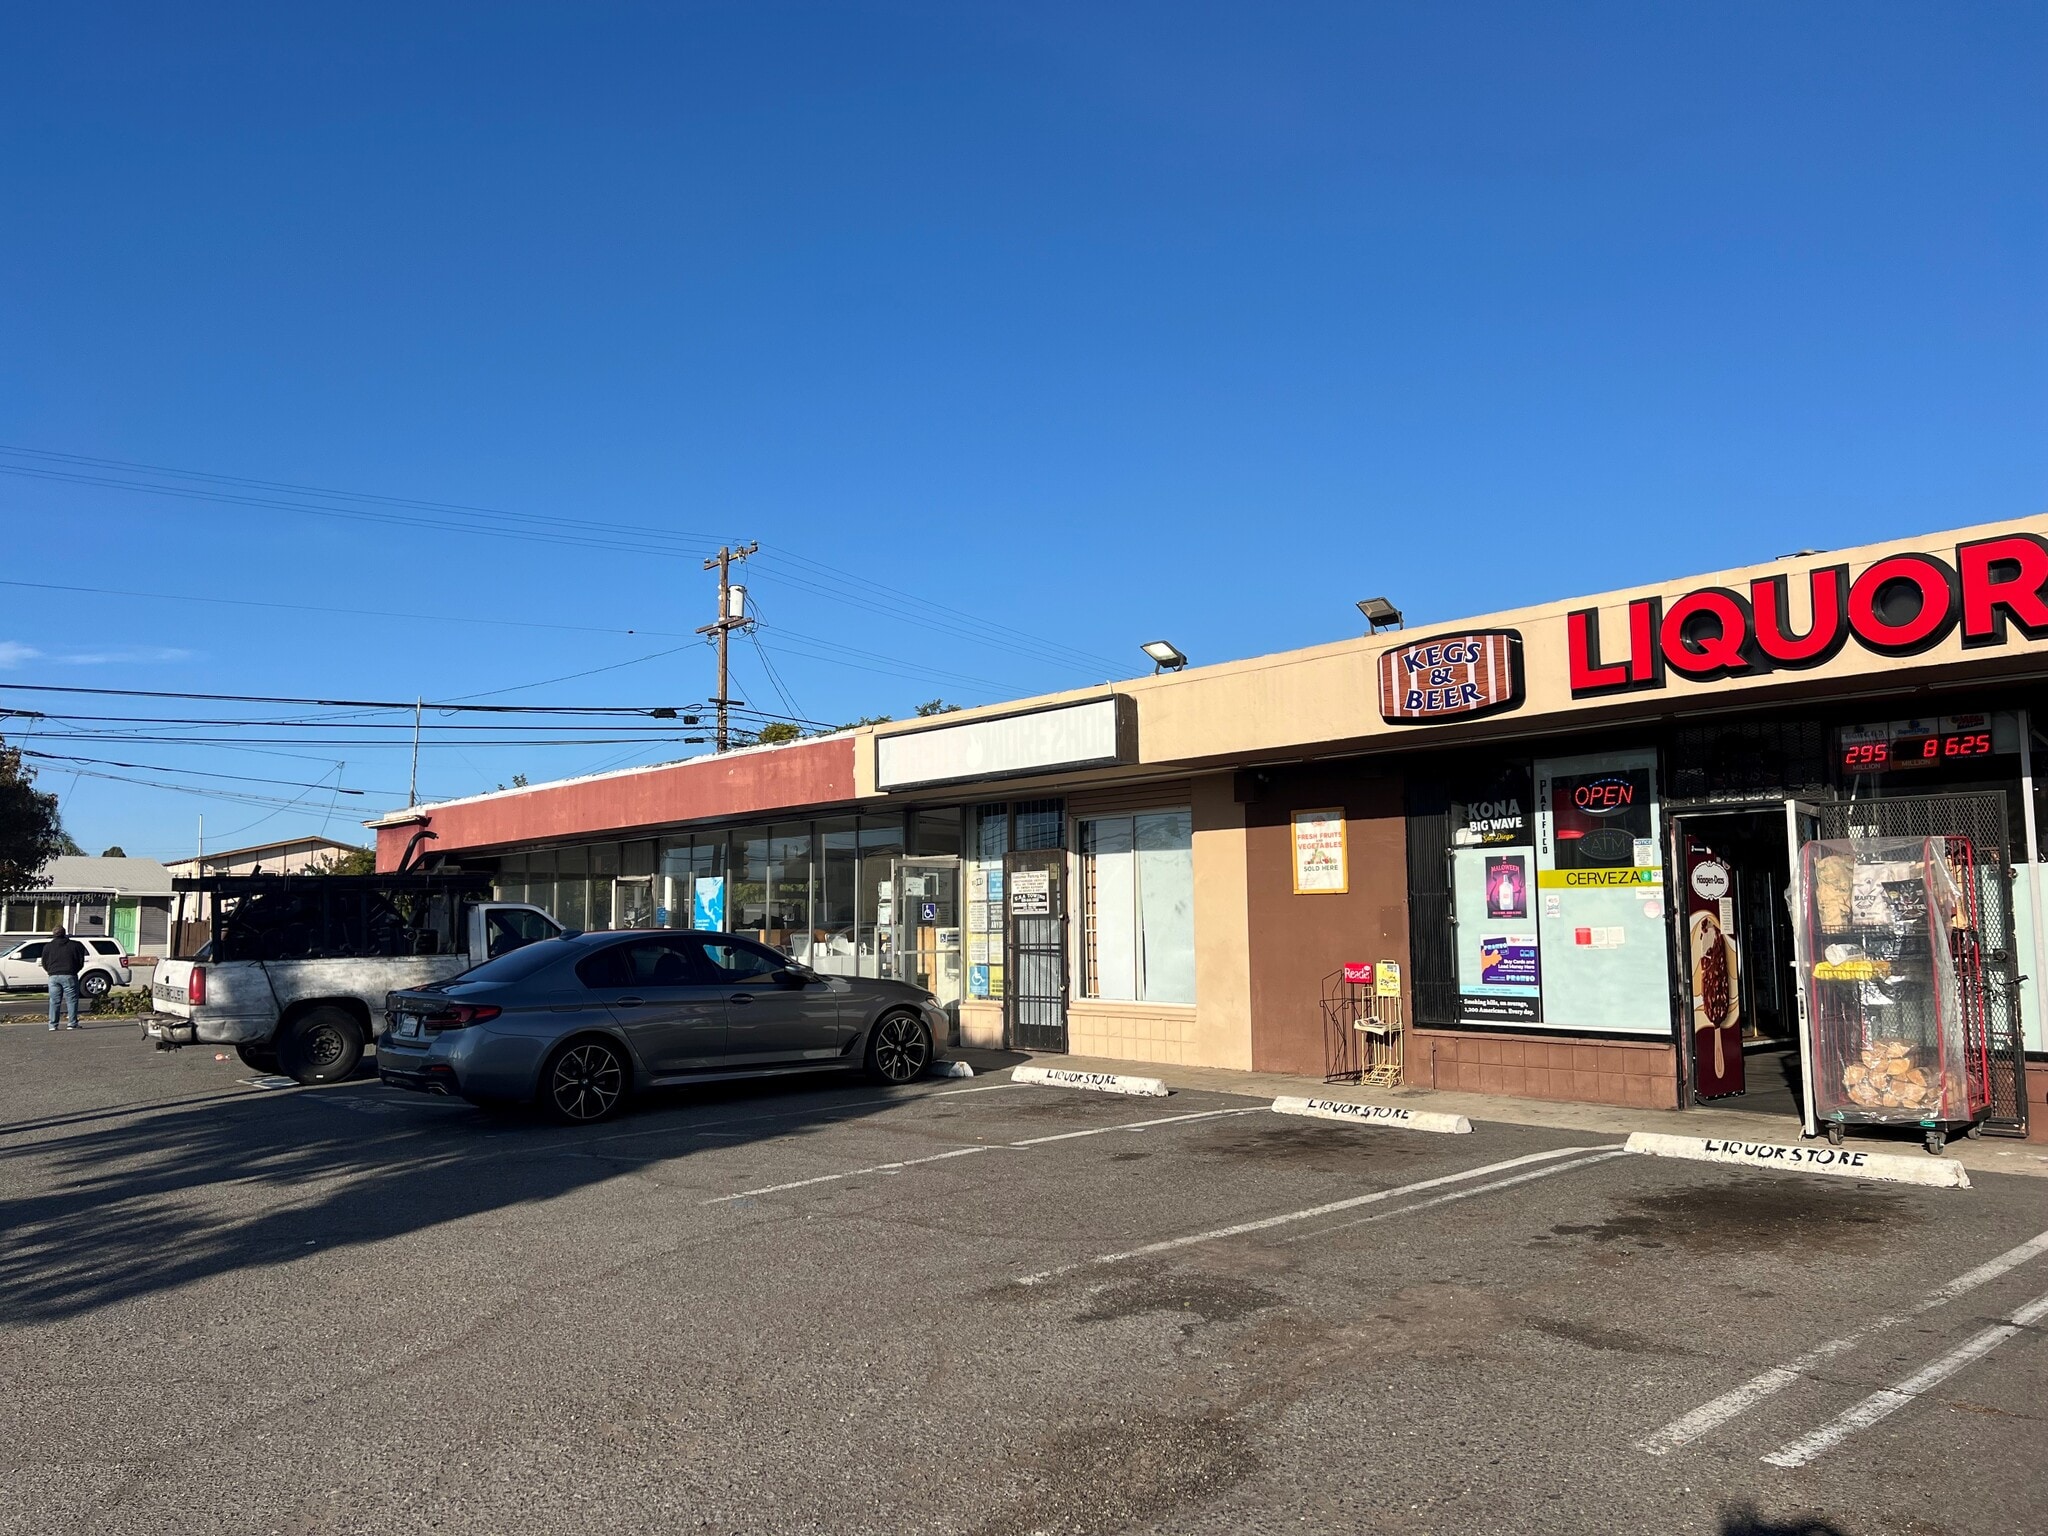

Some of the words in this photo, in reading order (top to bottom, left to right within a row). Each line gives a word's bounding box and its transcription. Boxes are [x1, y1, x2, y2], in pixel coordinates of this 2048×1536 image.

[1568, 533, 2048, 699] LIQUOR
[1403, 642, 1482, 674] KEGS
[1430, 666, 1456, 686] &
[1403, 682, 1486, 711] BEER
[1845, 744, 1887, 764] 295
[1923, 739, 1938, 758] 8
[1945, 735, 1990, 756] 625
[1575, 785, 1633, 806] OPEN
[1467, 799, 1521, 820] KONA
[1540, 780, 1548, 854] PACIFICO
[1470, 820, 1489, 832] BIG
[1489, 817, 1523, 830] WAVE
[1320, 831, 1343, 839] FRUITS
[1591, 837, 1626, 852] ATM
[1297, 841, 1343, 850] VEGETABLES
[1566, 870, 1641, 886] CERVEZA
[1464, 998, 1487, 1006] Smoking
